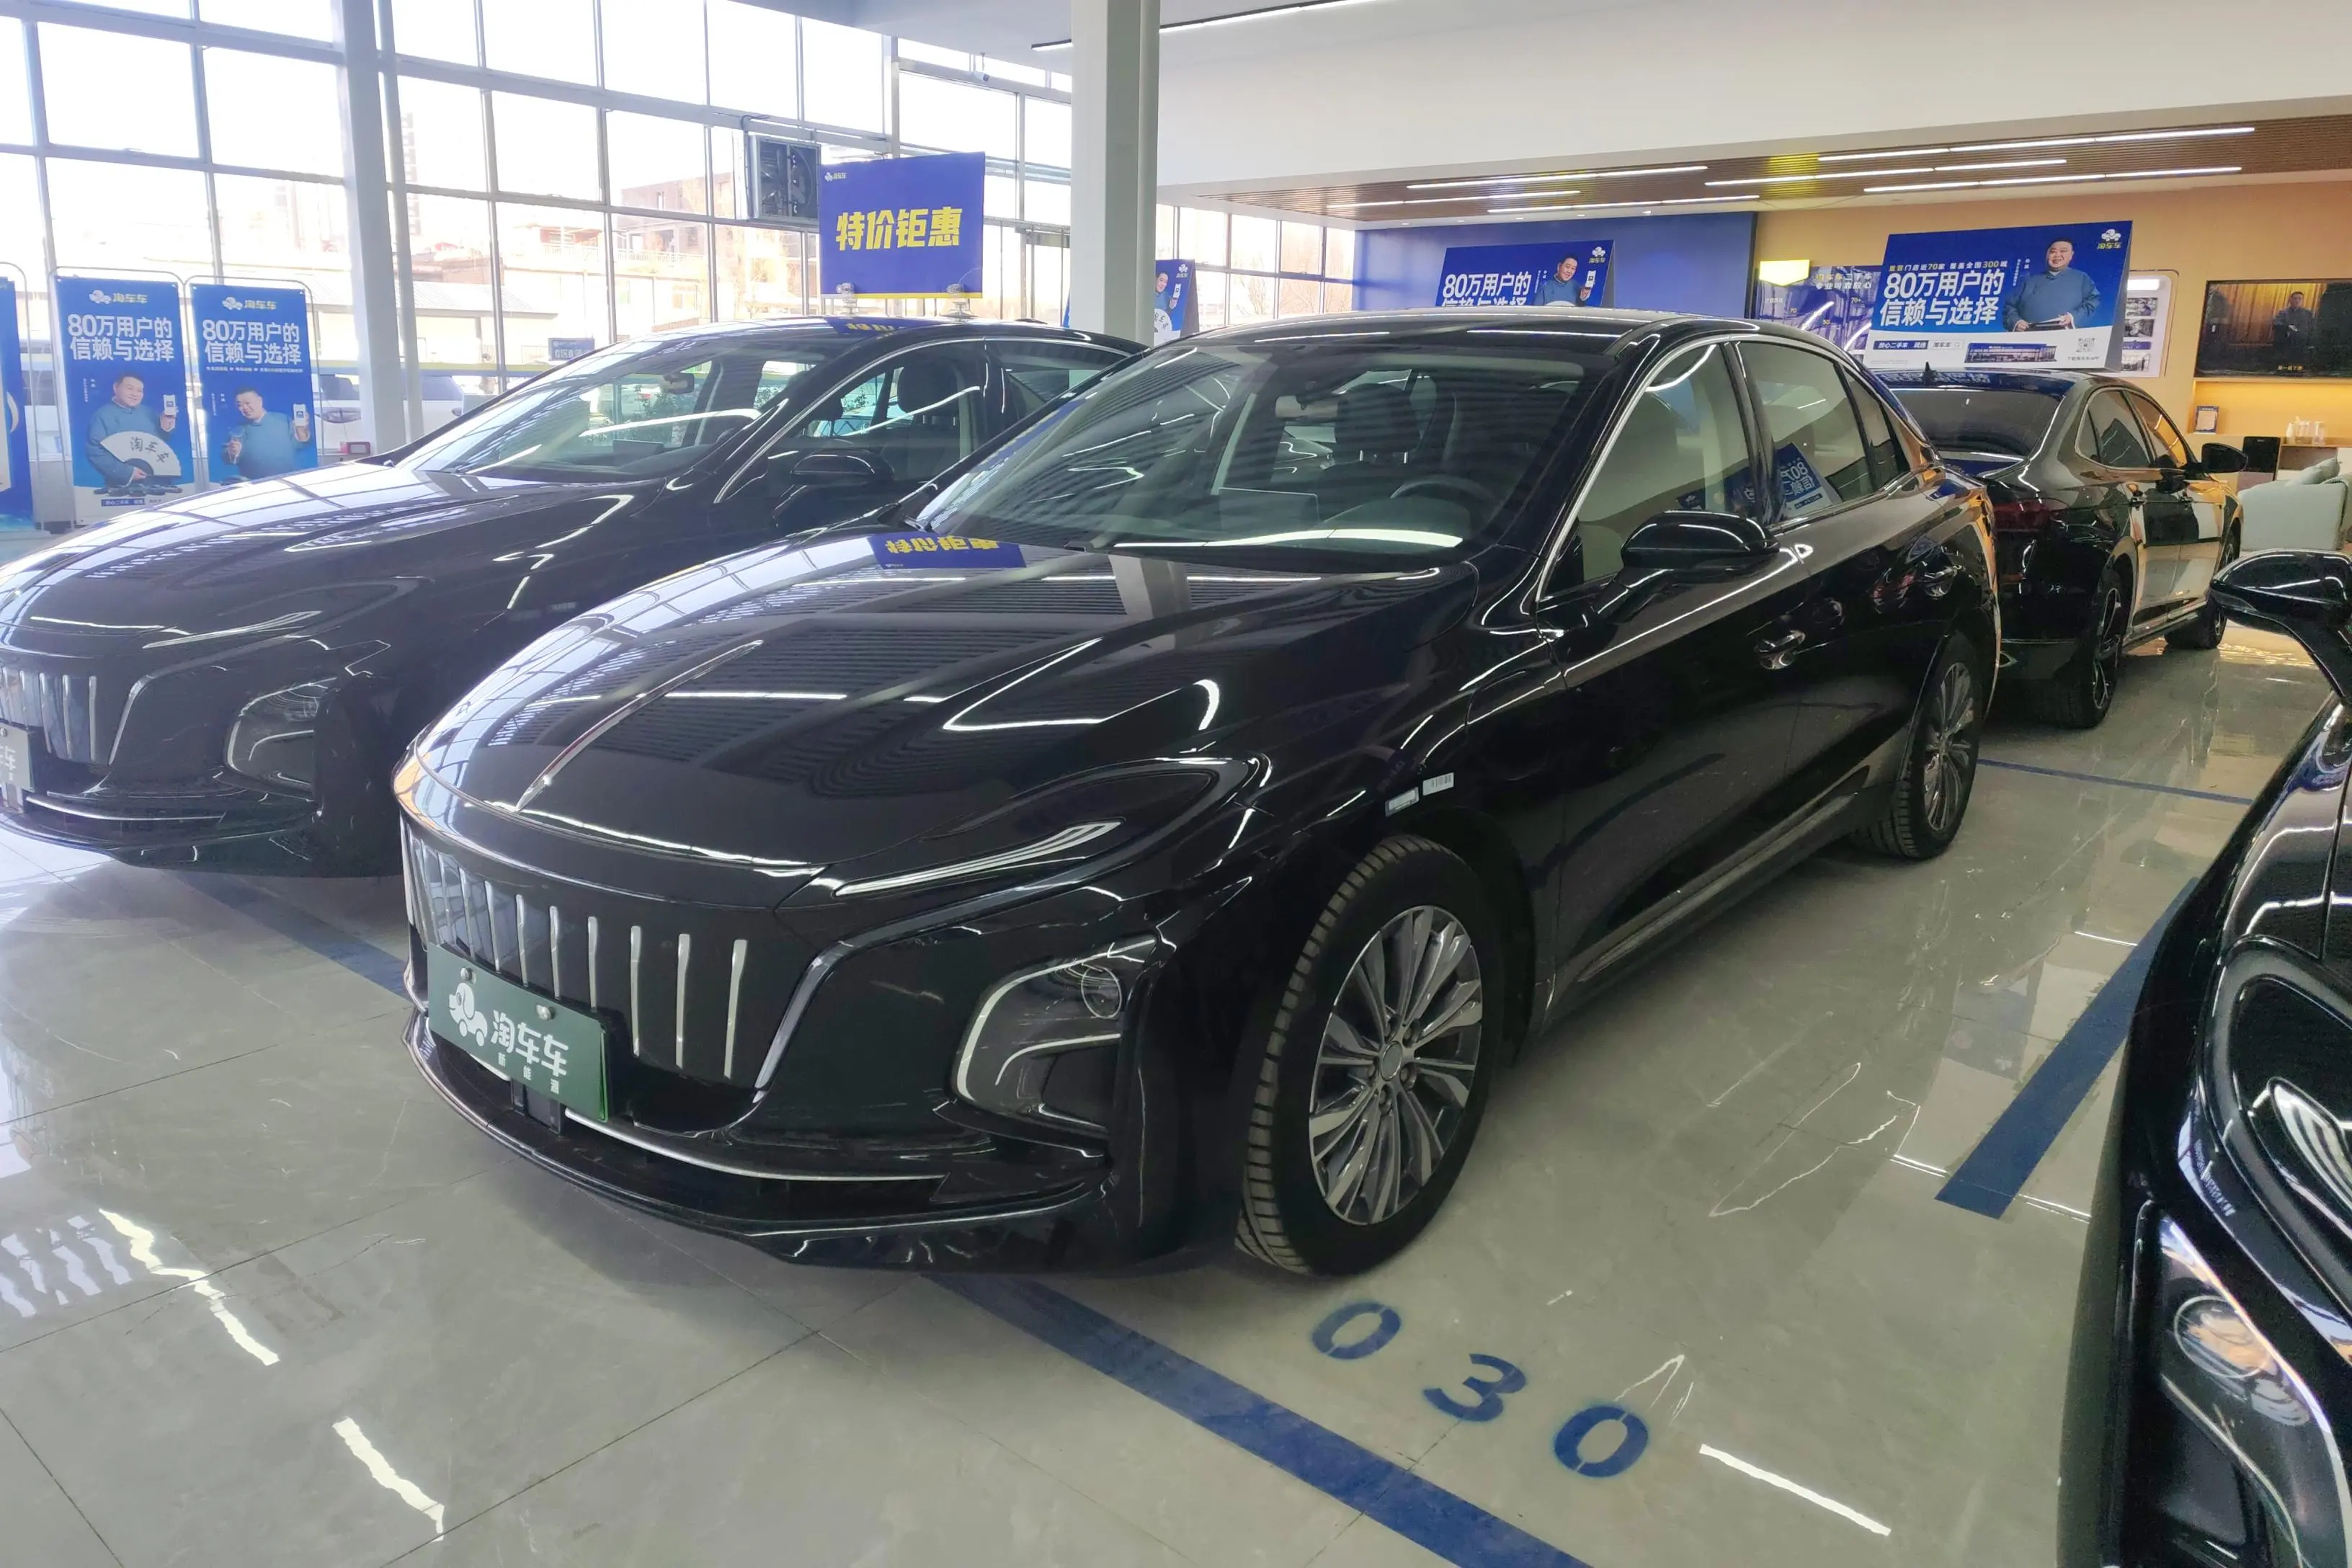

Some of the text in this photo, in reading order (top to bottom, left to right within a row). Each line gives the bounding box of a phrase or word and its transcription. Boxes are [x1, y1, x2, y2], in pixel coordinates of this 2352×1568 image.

[835, 206, 963, 251] 特价钜惠
[1442, 271, 1532, 298] 80万用户的
[1884, 268, 2005, 299] 80万用户的
[112, 293, 148, 303] 淘车车
[1879, 296, 2000, 326] 信赖与选择
[68, 313, 172, 339] 80万用户的
[202, 319, 300, 343] 80万用户的
[69, 337, 175, 362] 信赖与选择
[204, 340, 302, 365] 信赖与选择
[130, 437, 169, 463] 淘车车
[490, 1010, 569, 1077] 淘车车
